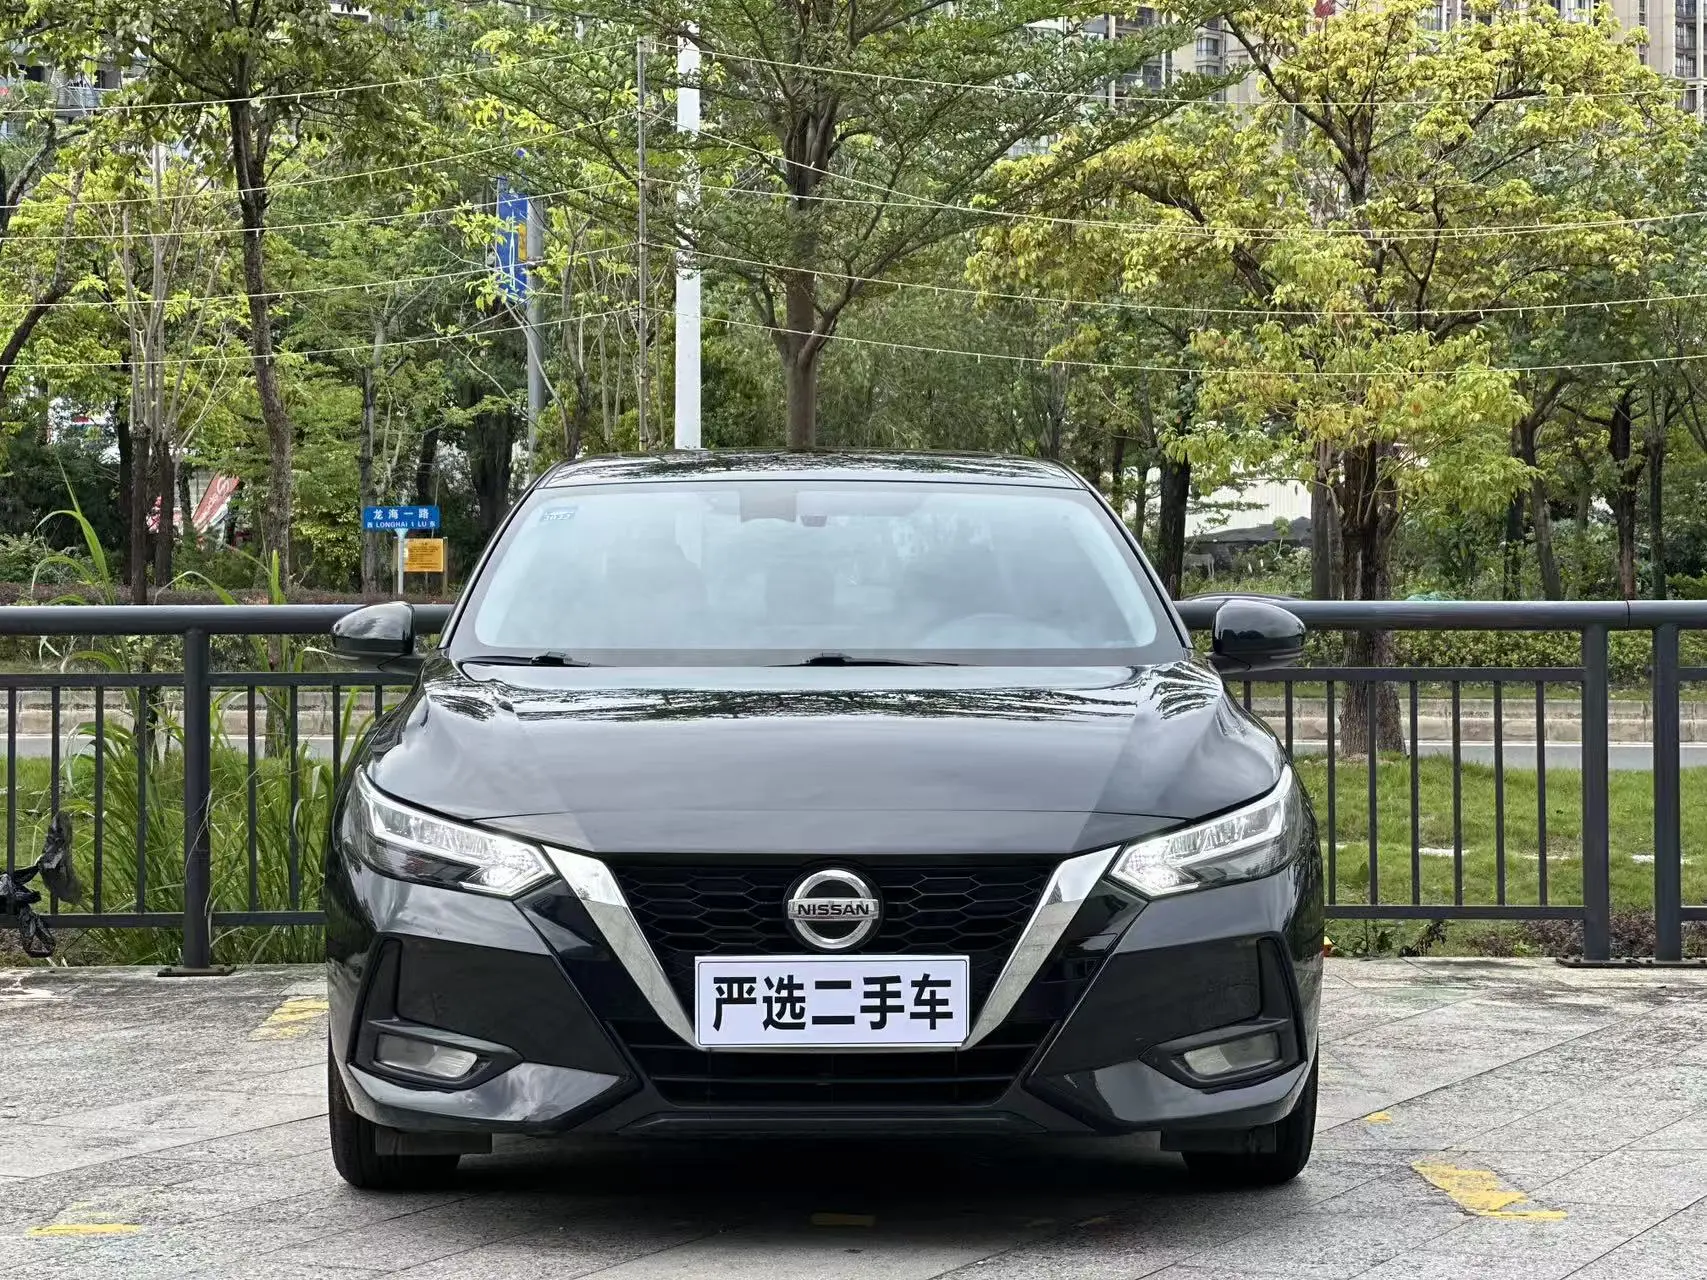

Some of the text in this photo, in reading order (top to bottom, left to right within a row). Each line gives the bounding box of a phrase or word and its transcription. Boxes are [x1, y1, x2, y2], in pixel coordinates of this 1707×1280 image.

[373, 508, 429, 520] 龙海一路
[798, 904, 869, 916] NISSAN
[713, 973, 953, 1032] 严选二手车
